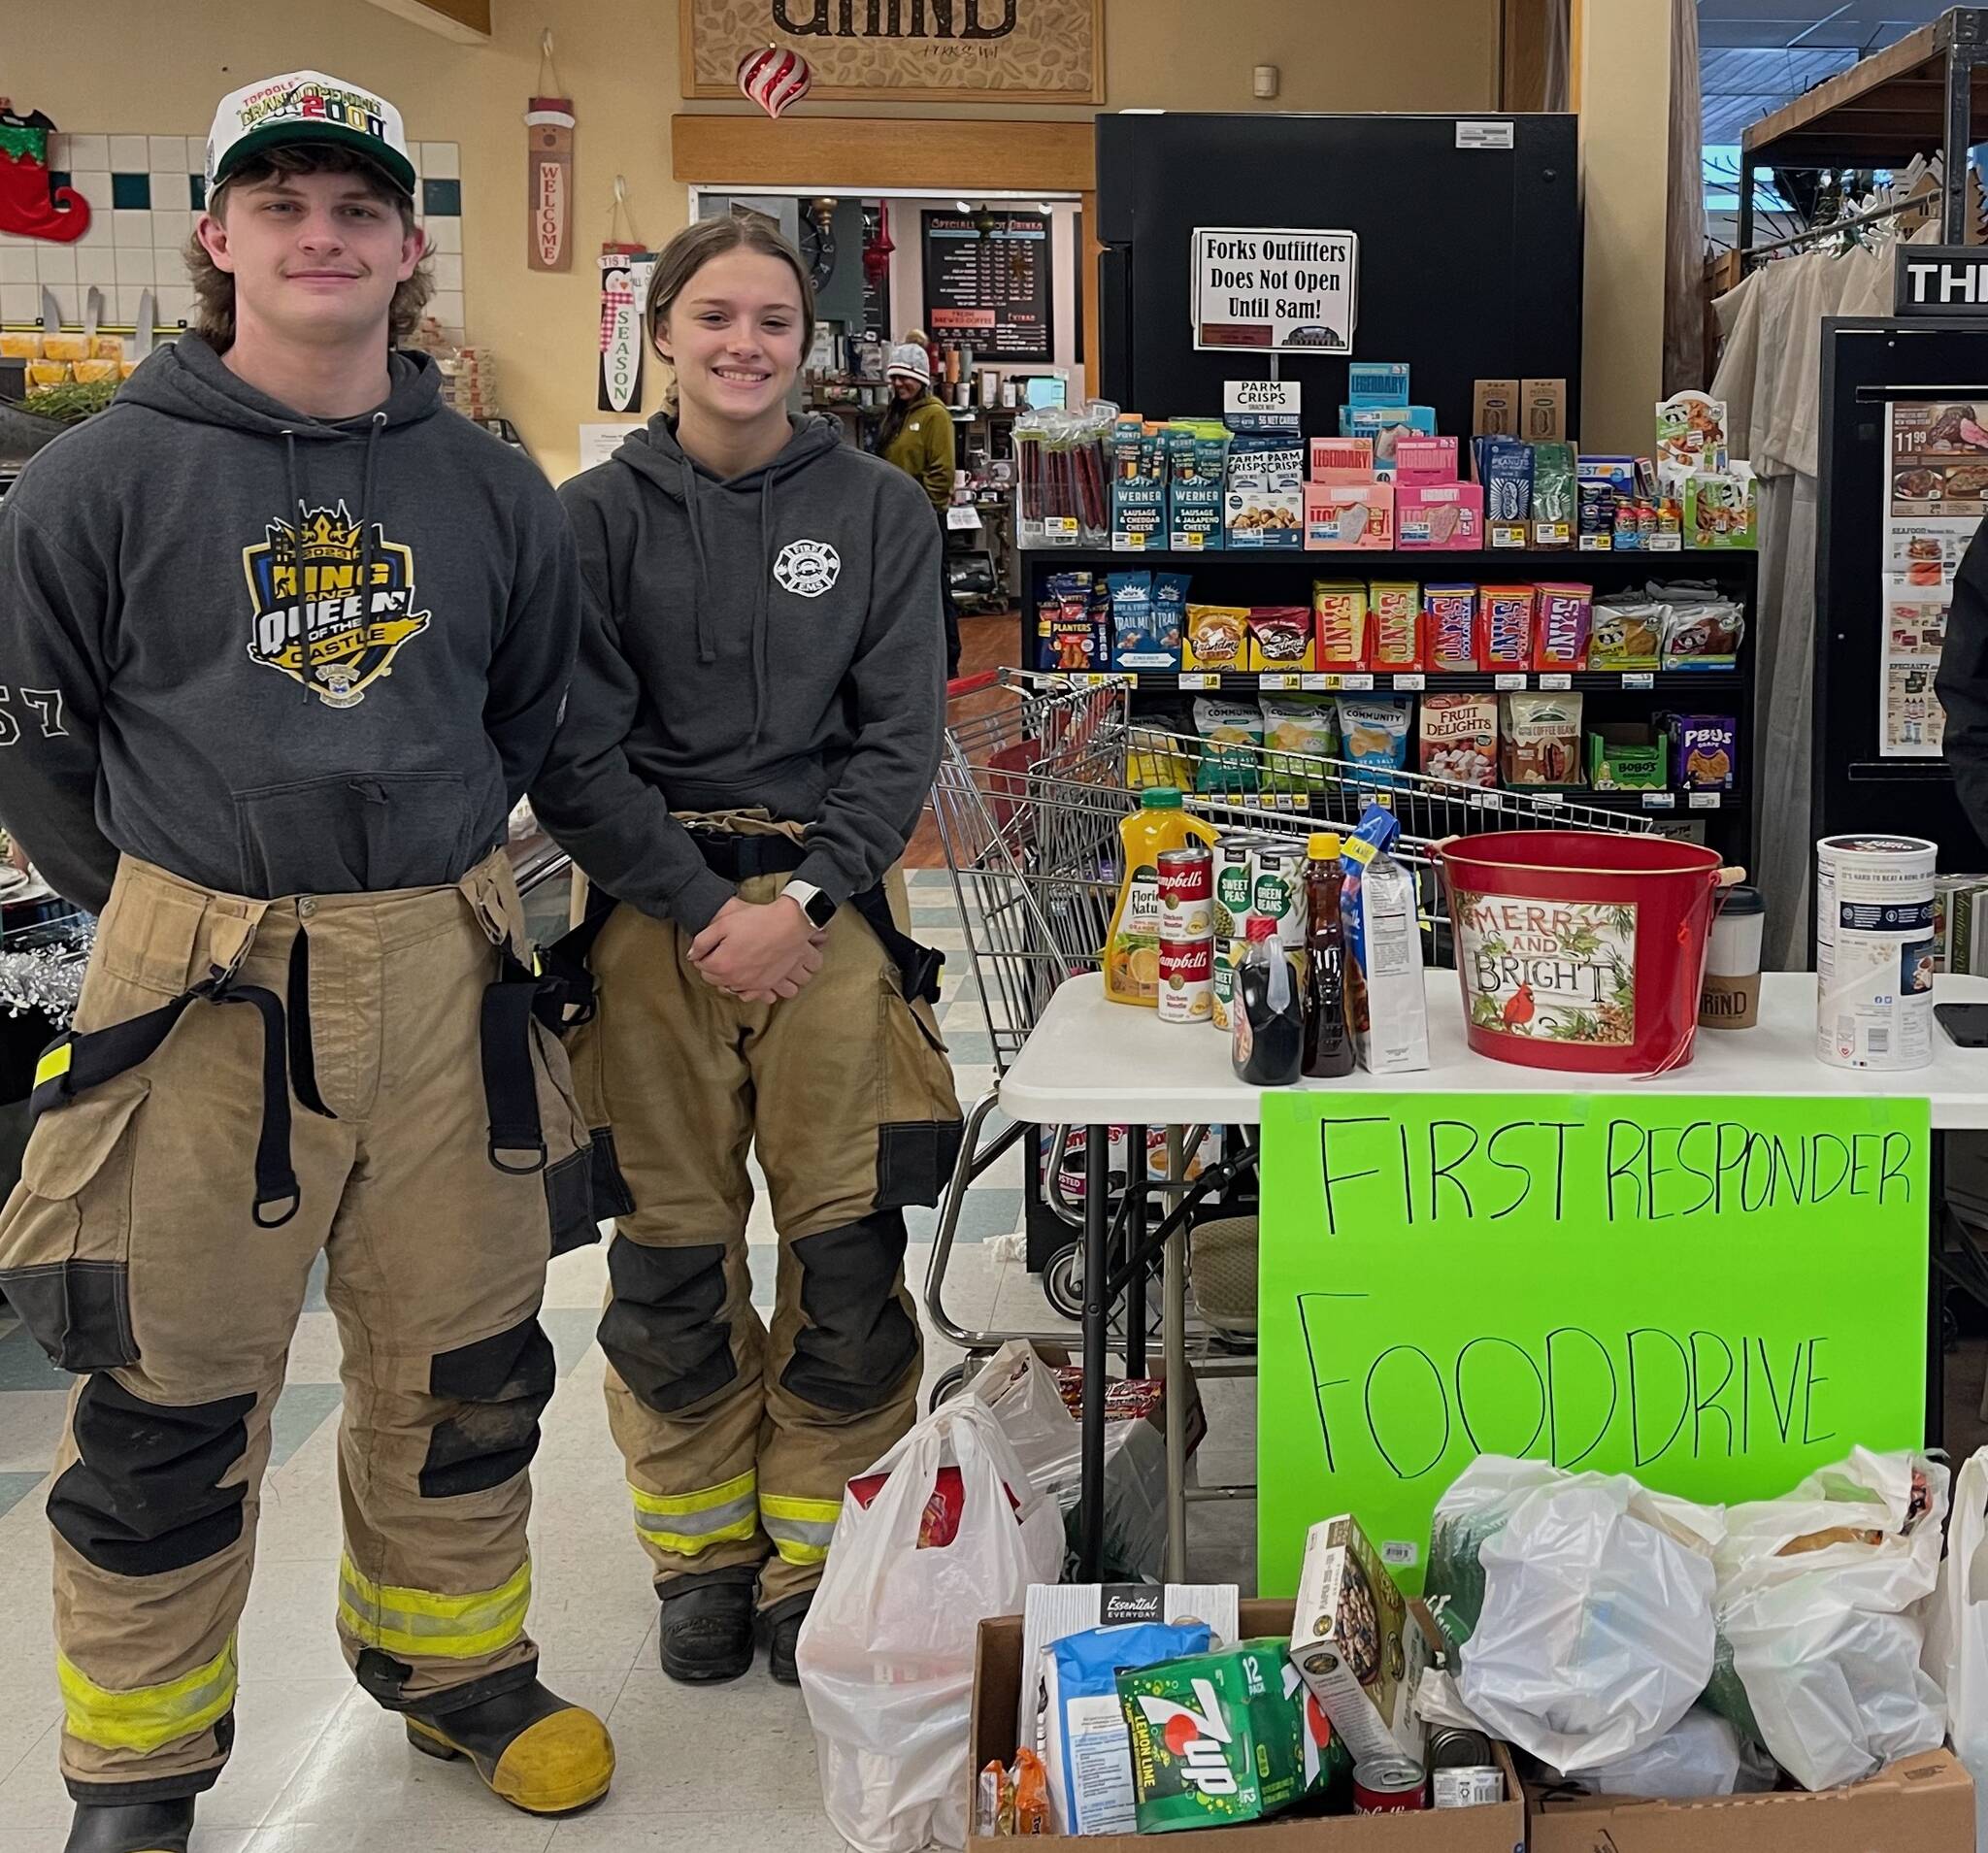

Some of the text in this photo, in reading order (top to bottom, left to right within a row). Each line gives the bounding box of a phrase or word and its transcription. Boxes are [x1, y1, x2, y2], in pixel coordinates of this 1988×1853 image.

[302, 96, 385, 141] 2000
[541, 166, 560, 260] WELCOME
[822, 244, 835, 252] 3
[1207, 239, 1346, 262] Forks Outfitters
[819, 262, 830, 274] 4
[1210, 268, 1341, 293] Does Not Open
[1229, 297, 1321, 318] Until 8am!
[613, 311, 632, 399] SEASON
[1242, 382, 1281, 392] PARM
[1238, 392, 1286, 405] CRISPS
[1228, 454, 1263, 464] PARM
[1268, 451, 1301, 462] PARM
[1227, 463, 1267, 474] CRISPS
[1117, 490, 1162, 501] WERNER
[1176, 490, 1218, 501] WERNER
[793, 545, 818, 554] FIRE
[273, 563, 389, 600] KING
[798, 581, 823, 591] EMS
[306, 588, 354, 602] AND
[259, 591, 406, 654] QUEEN
[308, 617, 362, 642] OF THE
[1053, 623, 1092, 632] PLANTERS
[291, 627, 385, 664] CASTLE
[1346, 711, 1402, 721] COMMUNITY
[1441, 708, 1478, 723] FRUIT
[1426, 719, 1492, 736] DELIGHTS
[1618, 762, 1658, 773] BOBO'S
[1222, 879, 1248, 891] SWEET
[1224, 891, 1245, 903] PEAS
[1257, 887, 1282, 900] GREEN
[1257, 900, 1282, 911] BEANS
[1473, 905, 1607, 938] MERRY
[1512, 936, 1558, 954] AND
[1474, 949, 1615, 1004] BRIGHT
[1320, 1116, 1914, 1237] FIRST RESPONDER
[1297, 1293, 1838, 1478] FOOD DRIVE
[1107, 1596, 1158, 1611] Essential
[1242, 1655, 1263, 1684] 12
[1134, 1715, 1156, 1788] LEMON LIME
